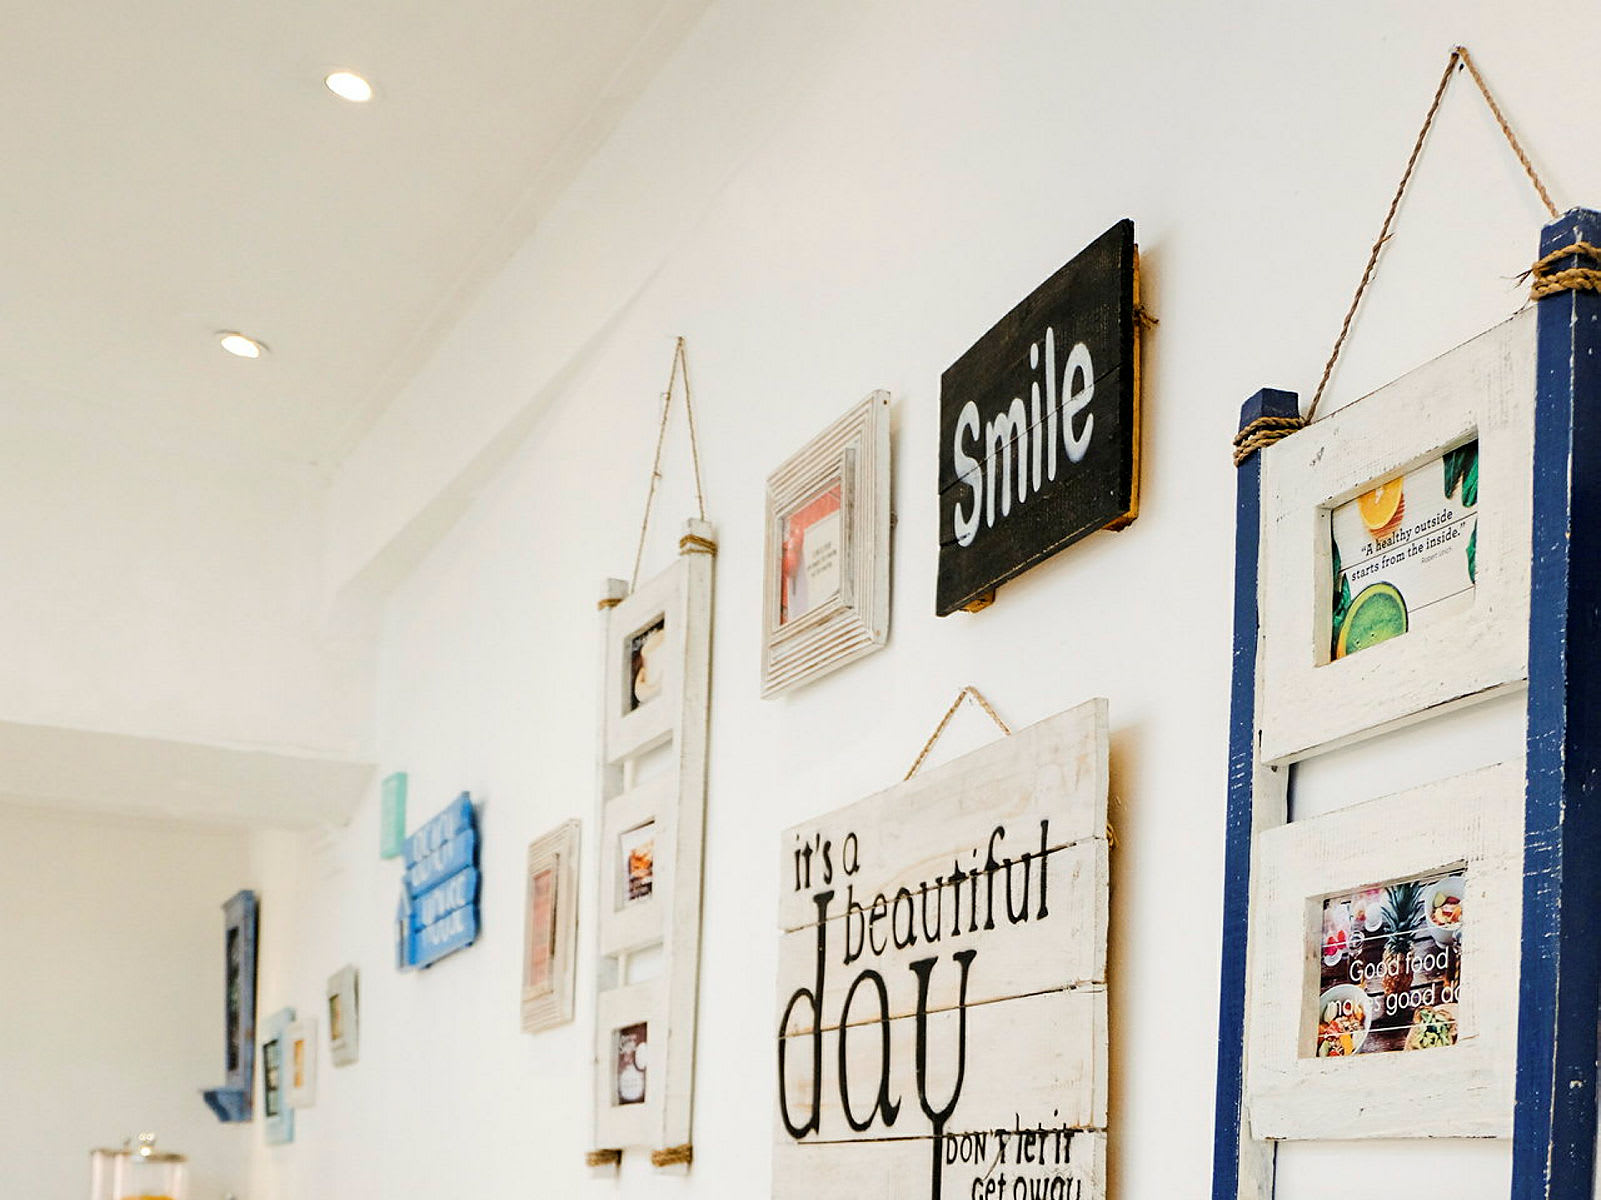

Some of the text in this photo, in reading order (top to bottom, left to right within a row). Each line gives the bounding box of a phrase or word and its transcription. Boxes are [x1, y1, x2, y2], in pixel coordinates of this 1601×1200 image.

[954, 327, 1095, 548] Smile
[1375, 528, 1413, 552] healthy
[1414, 508, 1453, 535] outside
[1351, 562, 1379, 581] starts
[1381, 551, 1405, 569] from
[1407, 542, 1424, 558] the
[794, 831, 861, 892] it's a
[843, 819, 1050, 965] beautiful
[1349, 945, 1449, 982] Good food
[1386, 982, 1435, 1016] good
